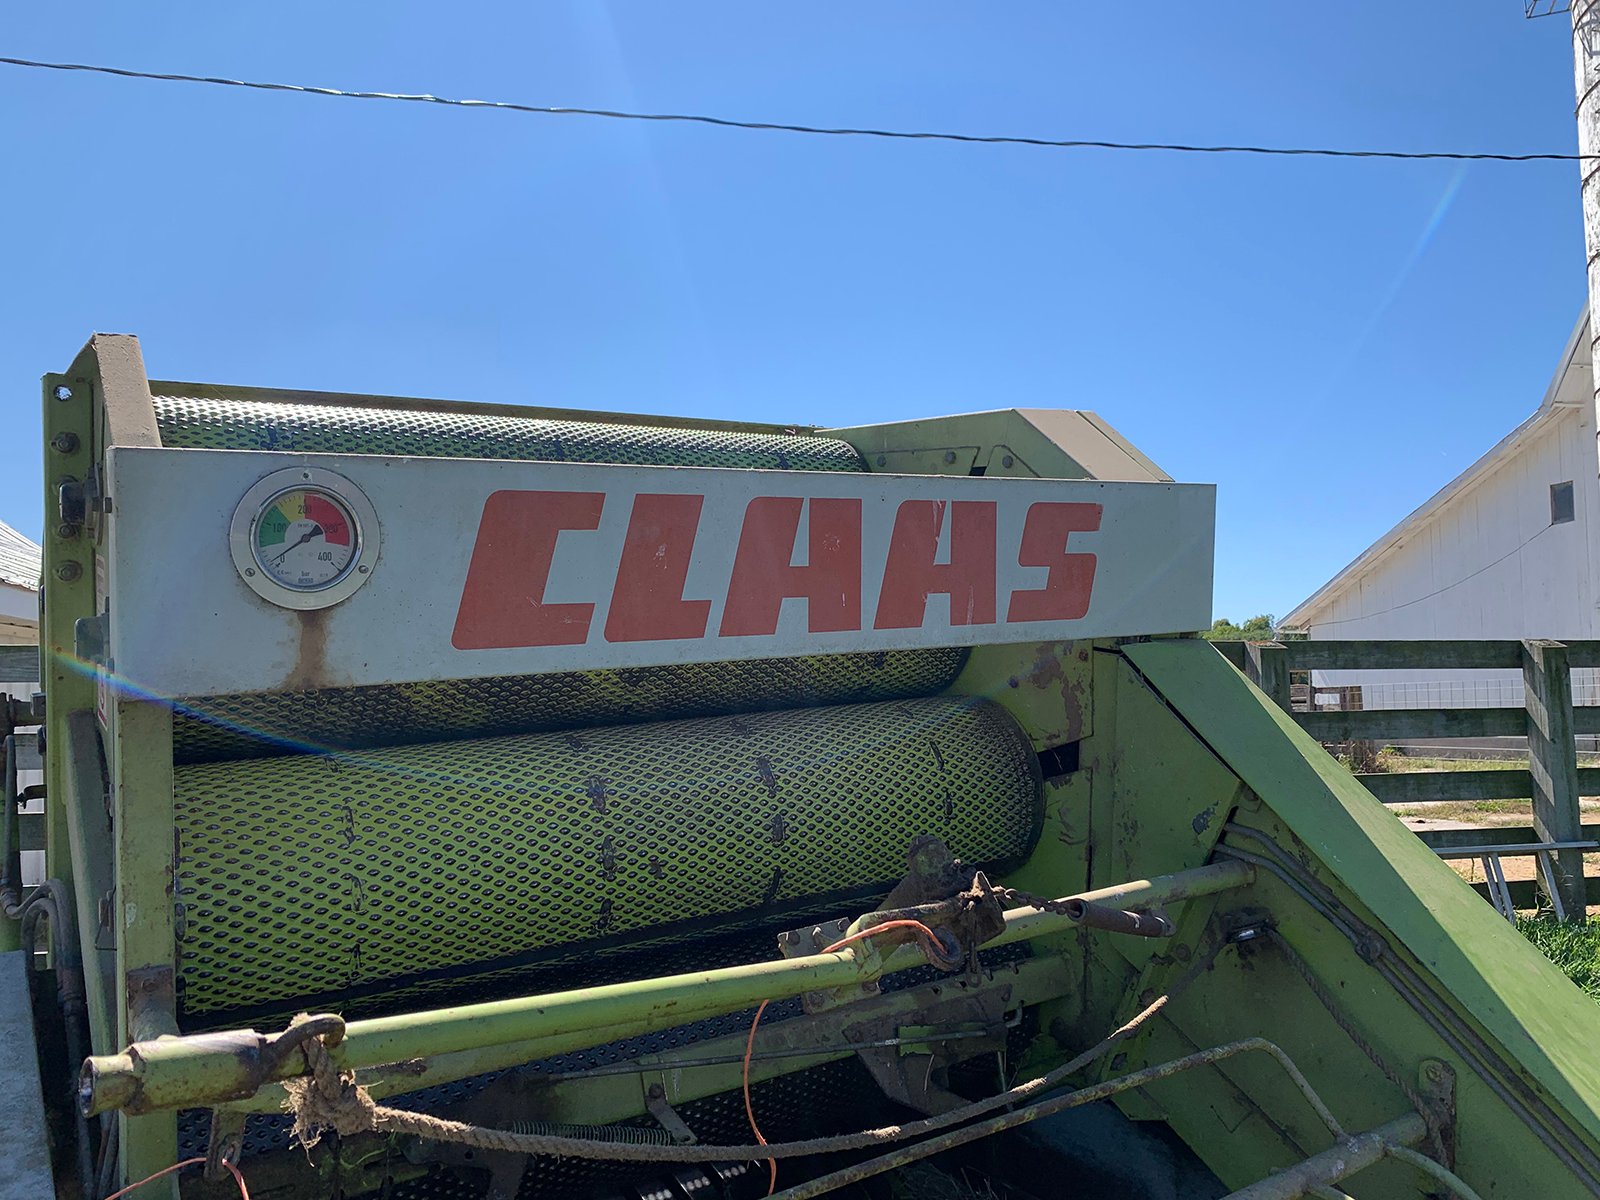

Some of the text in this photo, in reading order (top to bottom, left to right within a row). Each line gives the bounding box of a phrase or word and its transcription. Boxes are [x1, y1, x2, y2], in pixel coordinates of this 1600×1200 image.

[298, 504, 312, 514] 200
[273, 523, 286, 533] 100
[280, 554, 285, 563] 0
[317, 552, 332, 561] 400
[452, 490, 1102, 650] CLAAS
